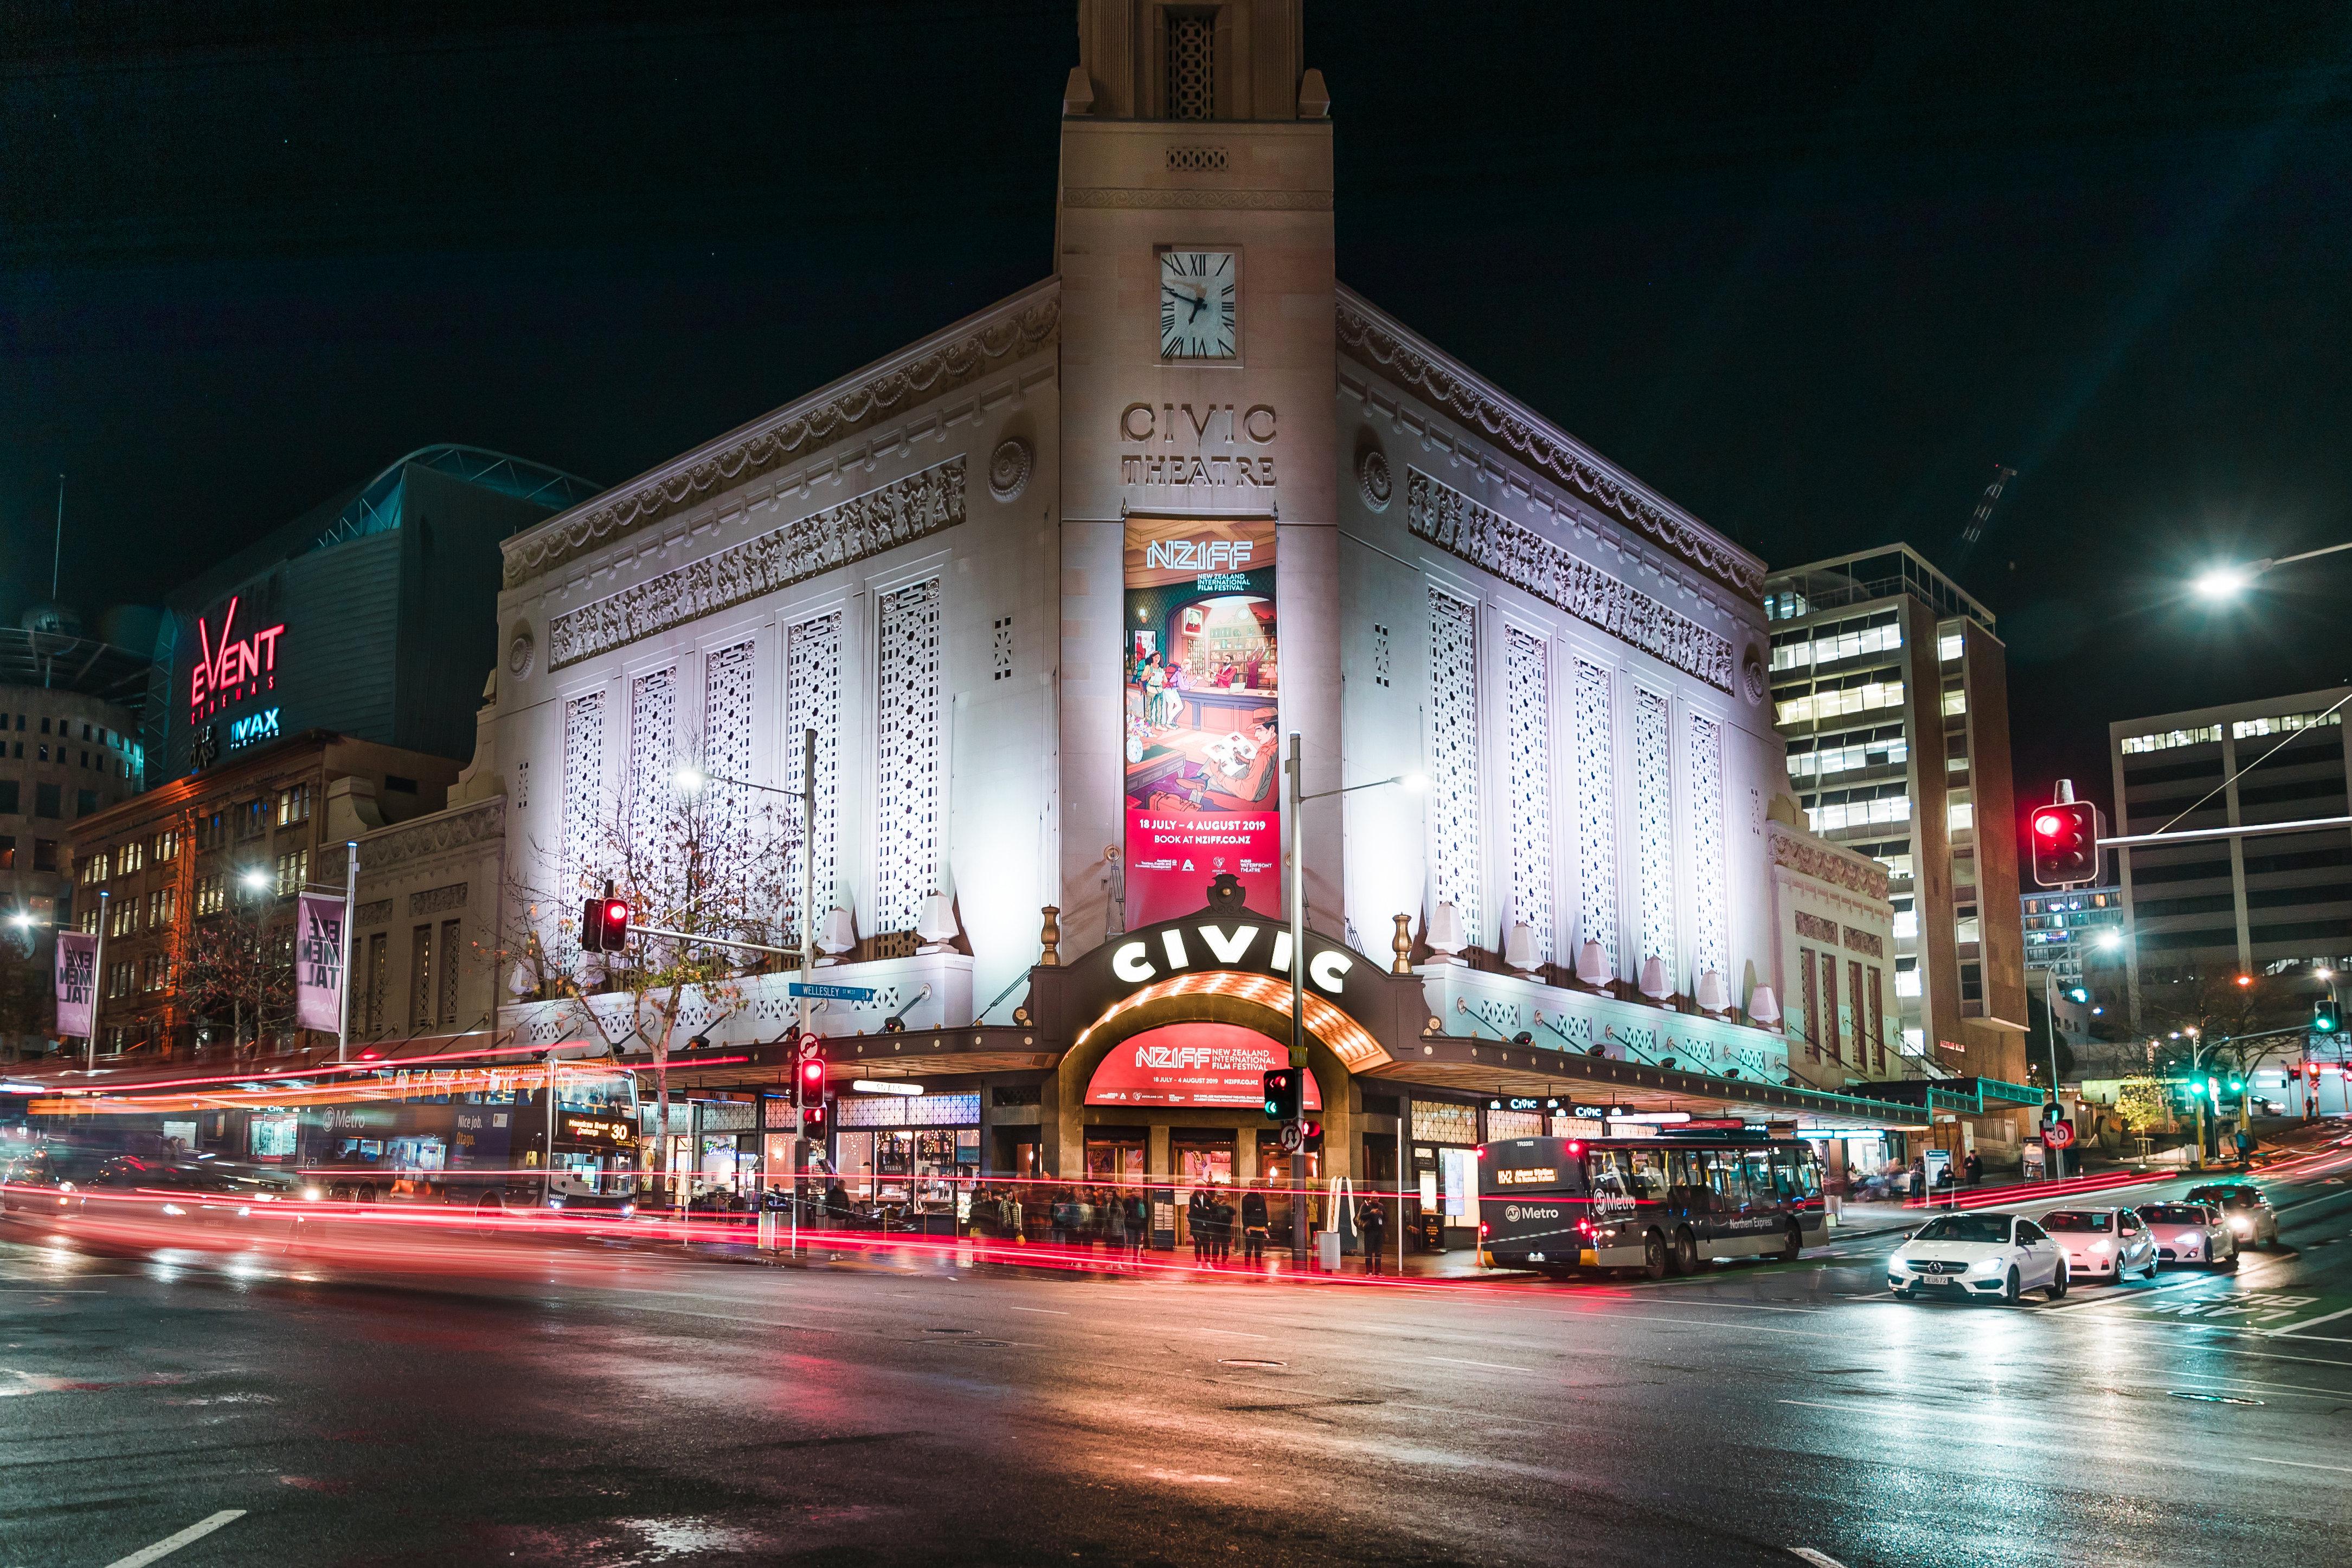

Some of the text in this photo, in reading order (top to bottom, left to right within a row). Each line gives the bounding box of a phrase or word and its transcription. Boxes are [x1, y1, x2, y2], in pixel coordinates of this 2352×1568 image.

[1190, 254, 1206, 276] XII
[1121, 402, 1276, 446] CIVIC
[1122, 455, 1276, 487] THEATRE
[1147, 539, 1253, 570] NZIFF
[191, 596, 285, 707] EVENT
[191, 676, 274, 725] CINEMAS
[232, 707, 279, 742] IMAX
[1140, 819, 1149, 828] 18
[1152, 820, 1177, 830] JULY
[1186, 821, 1194, 830] 4
[1196, 821, 1241, 831] AUGUST
[1243, 821, 1265, 831] 2019
[1154, 835, 1181, 843] BOOK
[1196, 836, 1251, 844] NZIFF.CO.NZ
[1113, 925, 1353, 993] CIVIC
[802, 985, 839, 997] WELLESLEY
[1135, 1046, 1211, 1069] NZIFF
[1212, 1056, 1276, 1064] INTERNATIONAL
[1232, 1049, 1269, 1057] ZEALAND
[335, 1110, 365, 1128] Metro
[458, 1115, 482, 1130] Nice job.
[456, 1132, 475, 1147] Otago.
[594, 1122, 609, 1130] Road
[611, 1124, 627, 1140] 30
[1606, 1192, 1636, 1210] Metro
[1522, 1207, 1558, 1219] Metro
[1730, 1217, 1773, 1230] Northern Express
